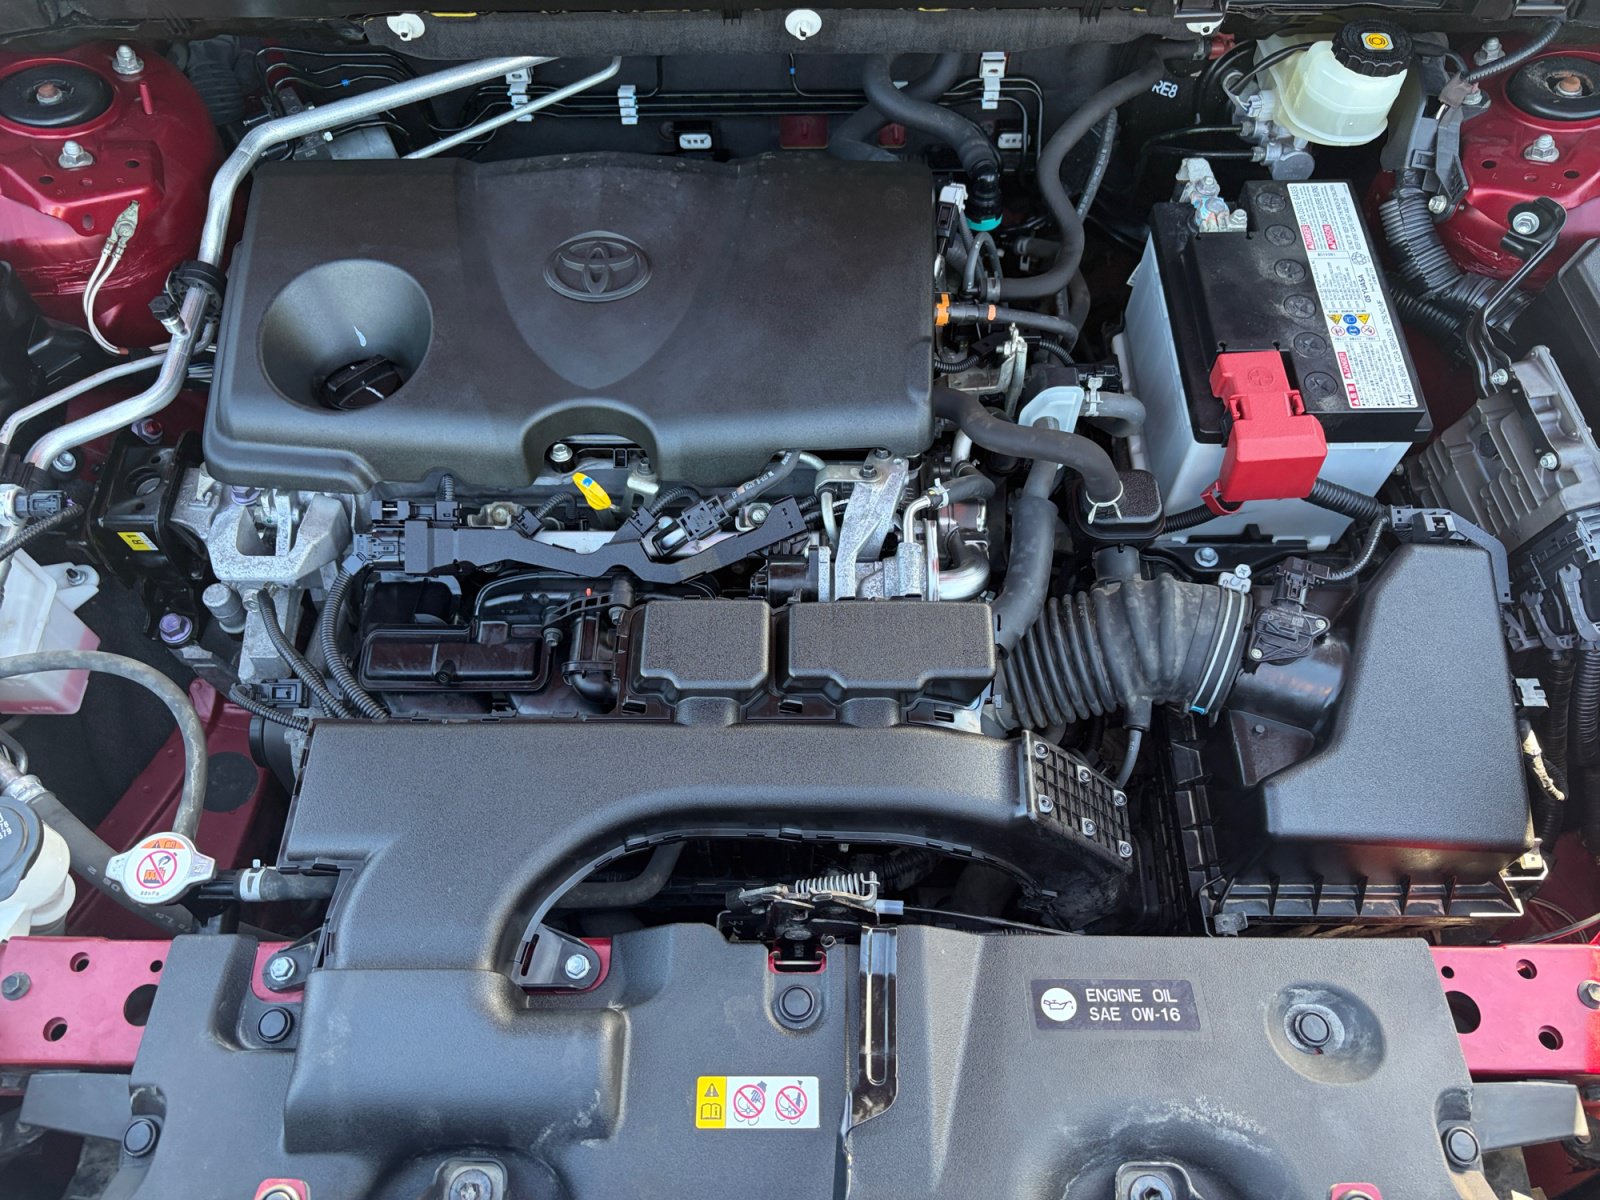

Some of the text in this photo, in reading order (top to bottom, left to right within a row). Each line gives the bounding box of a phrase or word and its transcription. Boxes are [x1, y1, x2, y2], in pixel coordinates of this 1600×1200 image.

[1322, 224, 1335, 244] POISON
[1356, 273, 1369, 293] YUASA
[1337, 352, 1351, 371] DANGER
[1398, 394, 1416, 405] A4
[1085, 988, 1178, 1003] ENGINE OIL
[1089, 1007, 1181, 1022] SAE 0W-16
